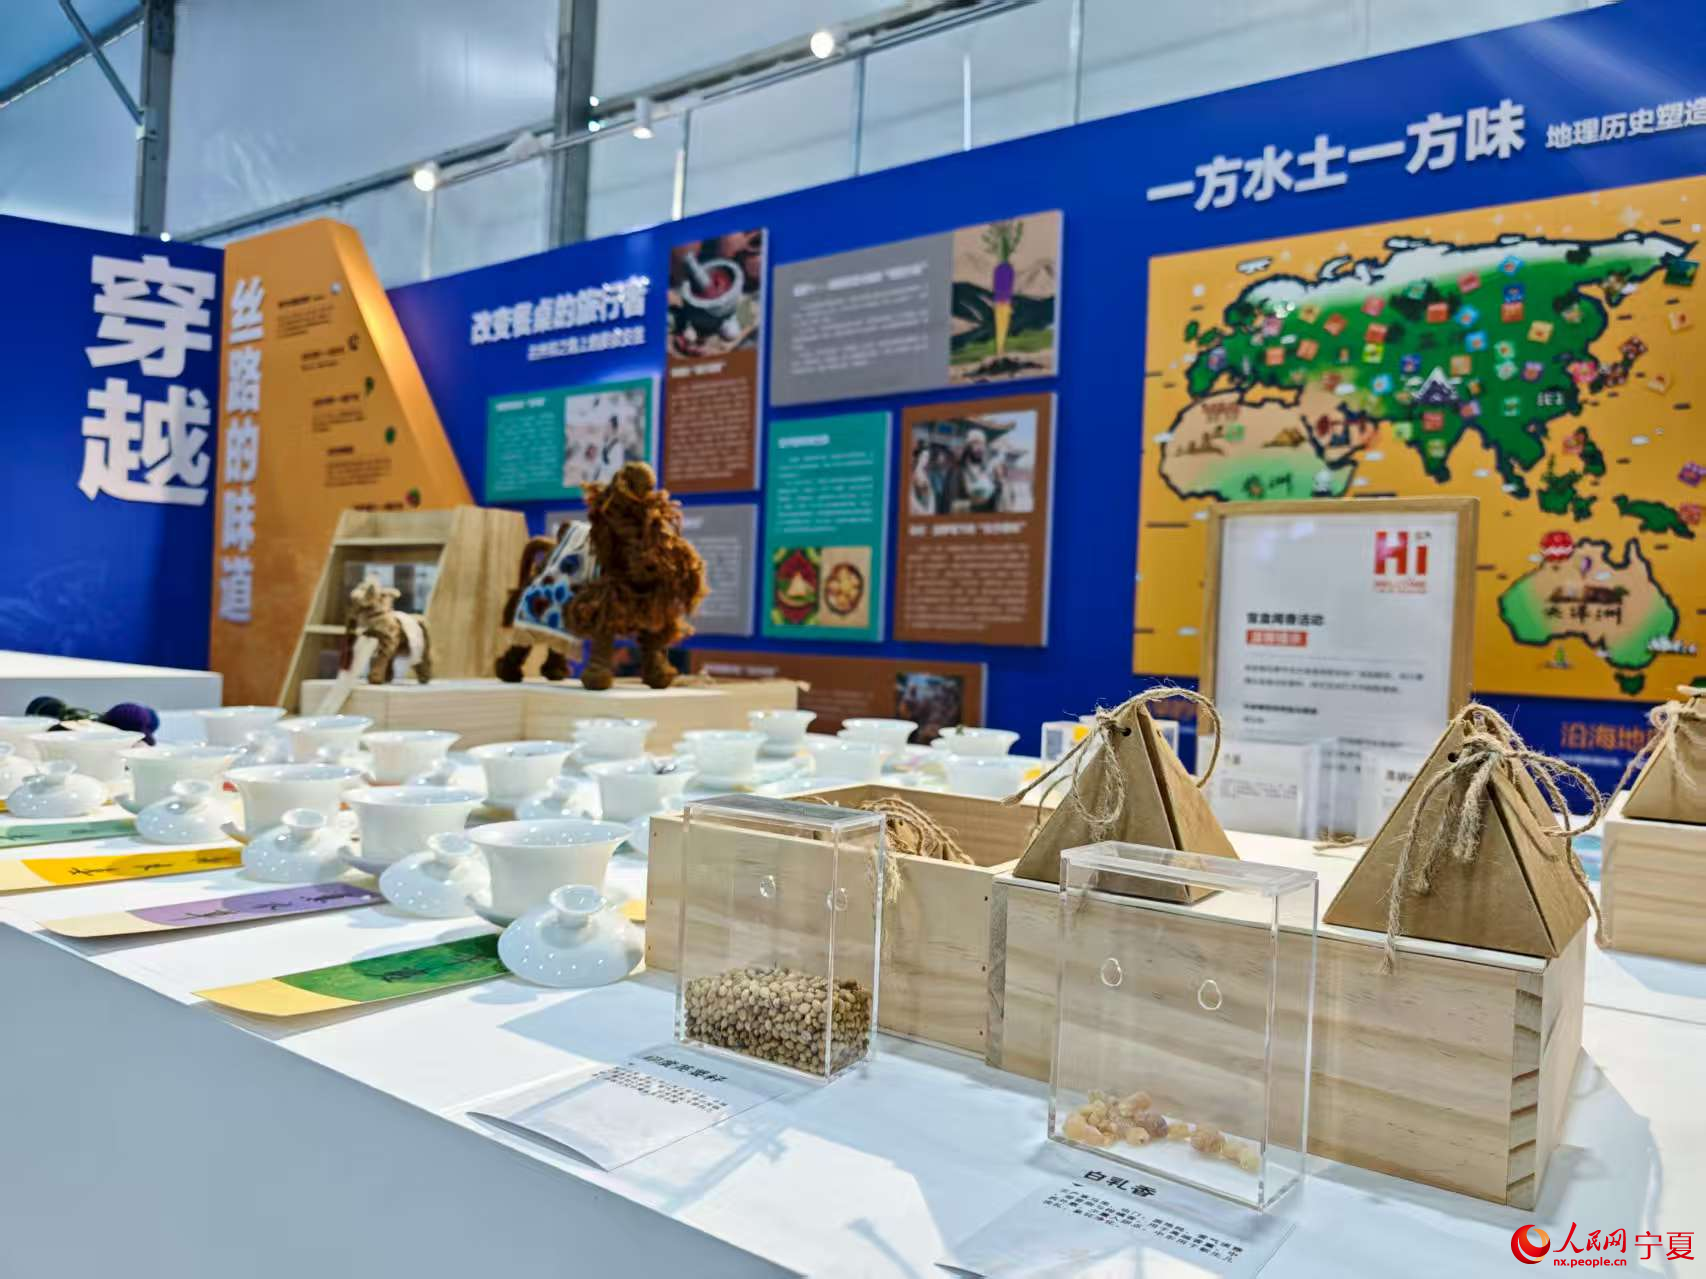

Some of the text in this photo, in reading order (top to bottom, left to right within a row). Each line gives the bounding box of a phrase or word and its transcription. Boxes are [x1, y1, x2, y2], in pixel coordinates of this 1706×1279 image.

[1545, 97, 1706, 151] 地理历史塑造
[1146, 99, 1527, 211] 一方水土一方味
[78, 255, 216, 506] 穿越
[219, 275, 265, 624] 丝路的味道
[1374, 531, 1428, 575] Hi
[1560, 721, 1655, 752] 沿海地
[1084, 1170, 1160, 1198] 白乳香
